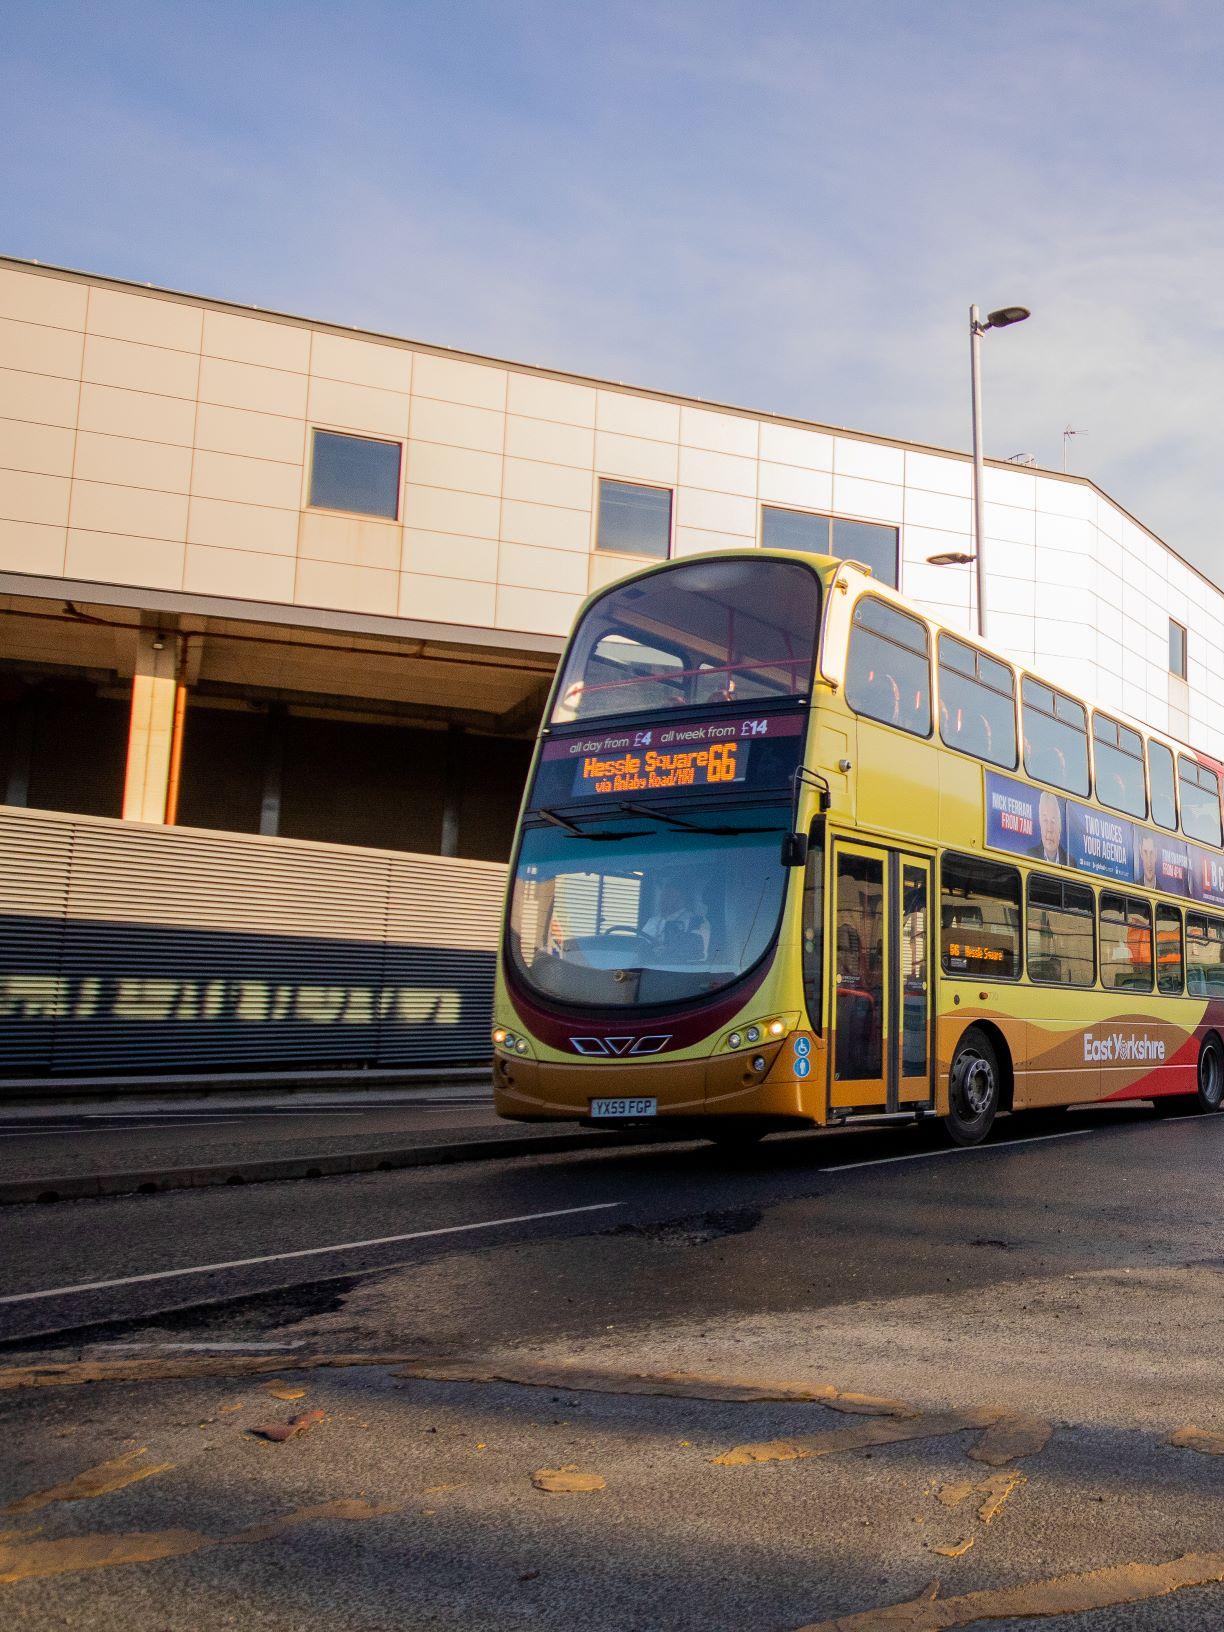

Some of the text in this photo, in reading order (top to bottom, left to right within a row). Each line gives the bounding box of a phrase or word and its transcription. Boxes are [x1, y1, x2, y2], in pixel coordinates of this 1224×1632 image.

[570, 719, 768, 754] all day from £4 all week from £14
[583, 743, 737, 782] Hessle Square 66
[595, 778, 611, 792] via
[992, 792, 1032, 819] NICK FERRARI
[1001, 812, 1033, 835] FROM 7AM
[1085, 814, 1122, 844] TWO VOICES
[1083, 834, 1127, 864] YOUR AGENDA
[1083, 1033, 1165, 1061] East Yorkshire
[597, 1099, 652, 1115] YX59 FGP
